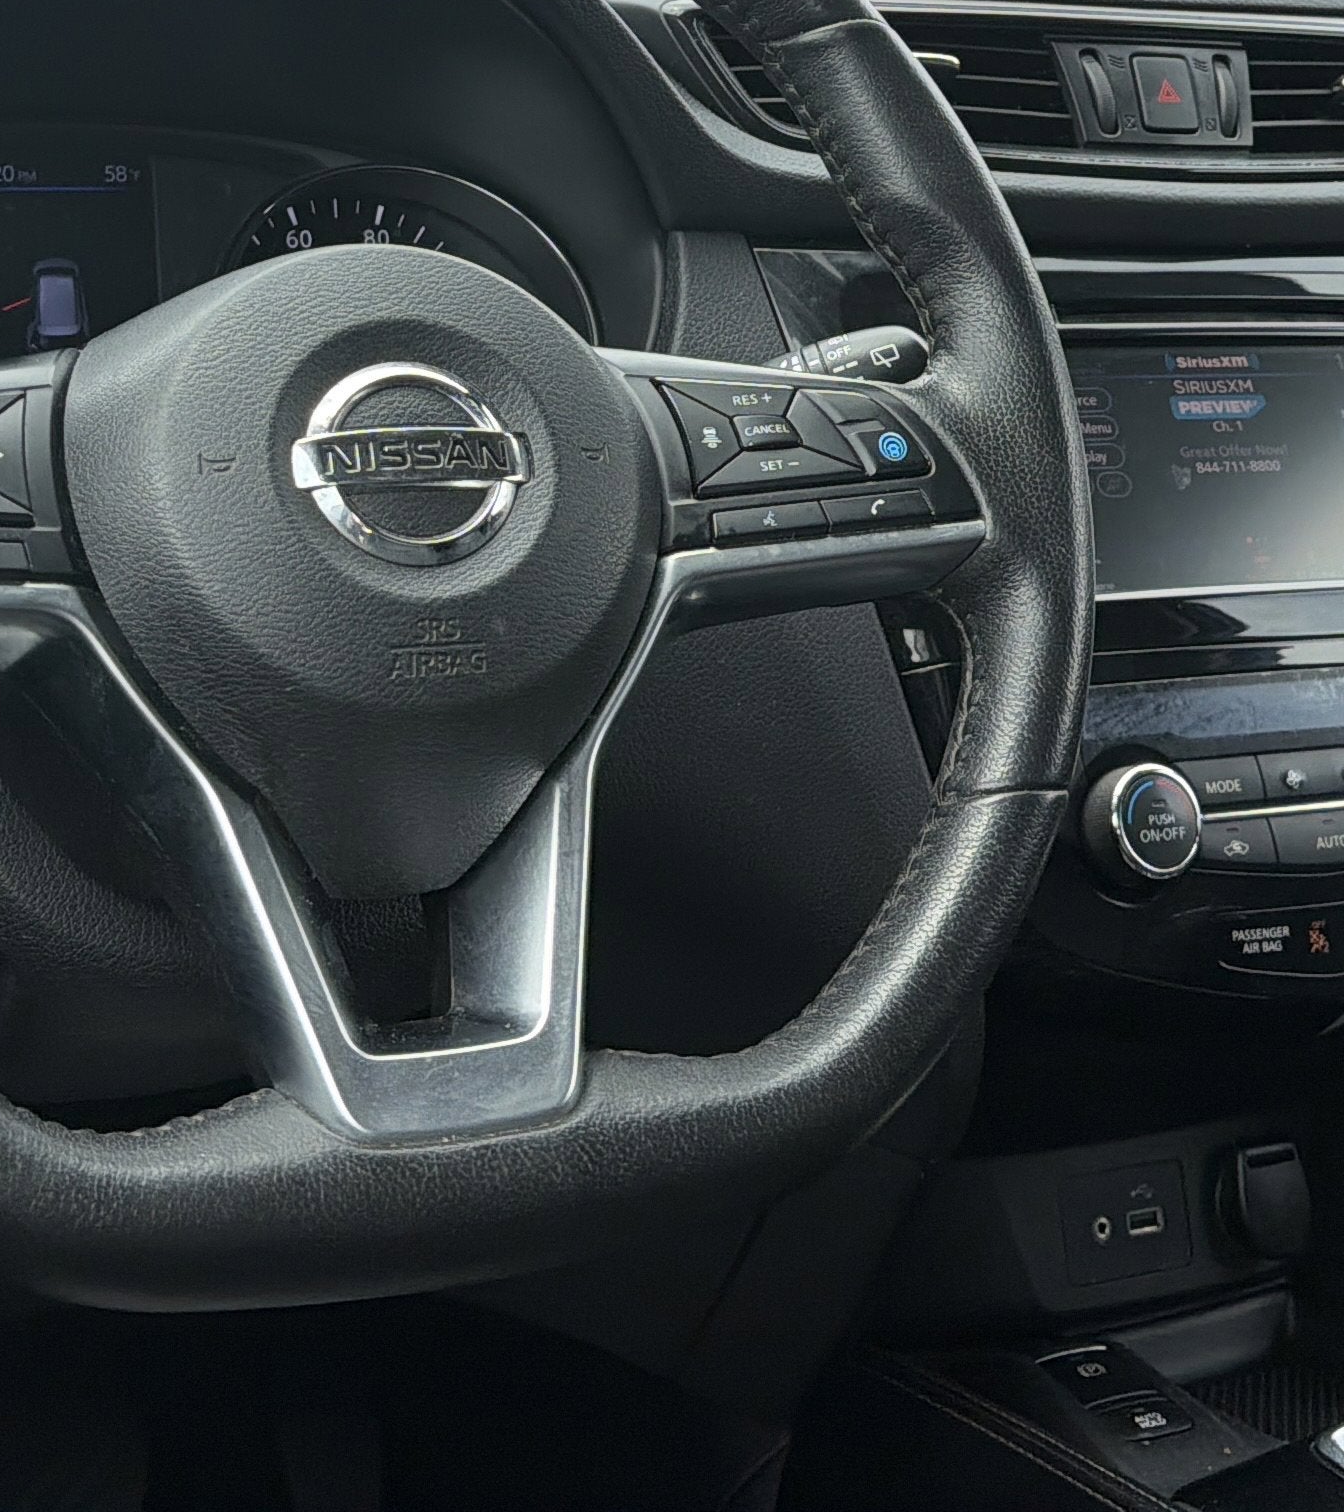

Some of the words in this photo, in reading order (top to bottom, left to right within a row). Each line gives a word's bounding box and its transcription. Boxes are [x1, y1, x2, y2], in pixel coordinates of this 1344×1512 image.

[285, 229, 313, 249] 60
[363, 229, 390, 244] 80
[826, 345, 852, 361] OFF
[1173, 379, 1254, 395] SIRIUSXM
[732, 393, 758, 407] RES
[1077, 396, 1098, 406] rce
[1178, 399, 1258, 415] PREVIEW
[744, 423, 790, 437] CANCEL
[1236, 419, 1243, 432] 1
[321, 433, 511, 476] NISSAN
[1180, 445, 1217, 459] Great
[759, 459, 785, 472] SET
[415, 618, 463, 642] SRS
[389, 649, 488, 681] AIRBAG
[1205, 777, 1243, 795] MODE
[1148, 813, 1176, 826] PUSH
[1231, 925, 1291, 942] PASSENGER
[1242, 940, 1261, 955] AIR
[1263, 939, 1284, 953] BAG
